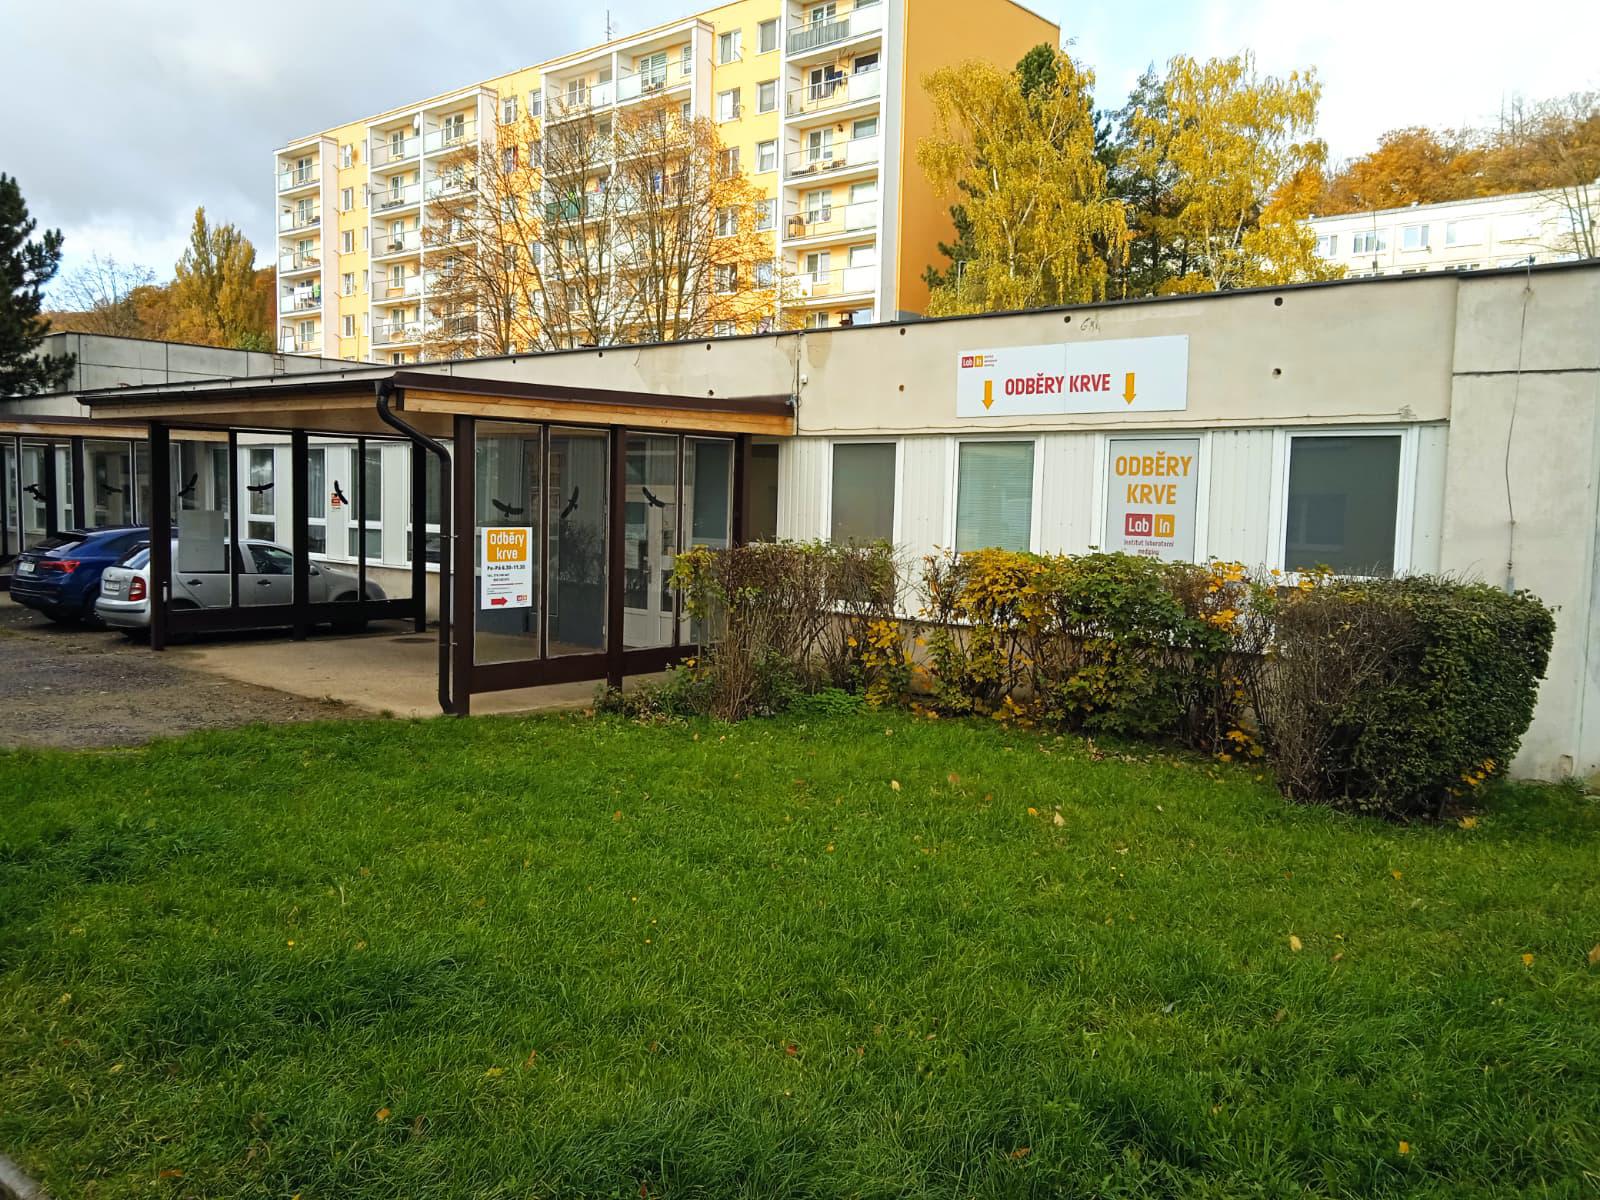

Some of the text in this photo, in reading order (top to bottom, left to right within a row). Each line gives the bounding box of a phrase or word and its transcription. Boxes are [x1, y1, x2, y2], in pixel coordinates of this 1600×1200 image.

[1005, 373, 1111, 396] ODBĚRY KRVE
[1115, 451, 1192, 477] ODBĚRY
[1126, 483, 1177, 505] KRVE
[1128, 517, 1171, 534] Lab In
[490, 531, 525, 547] Odběry
[496, 547, 518, 560] krve
